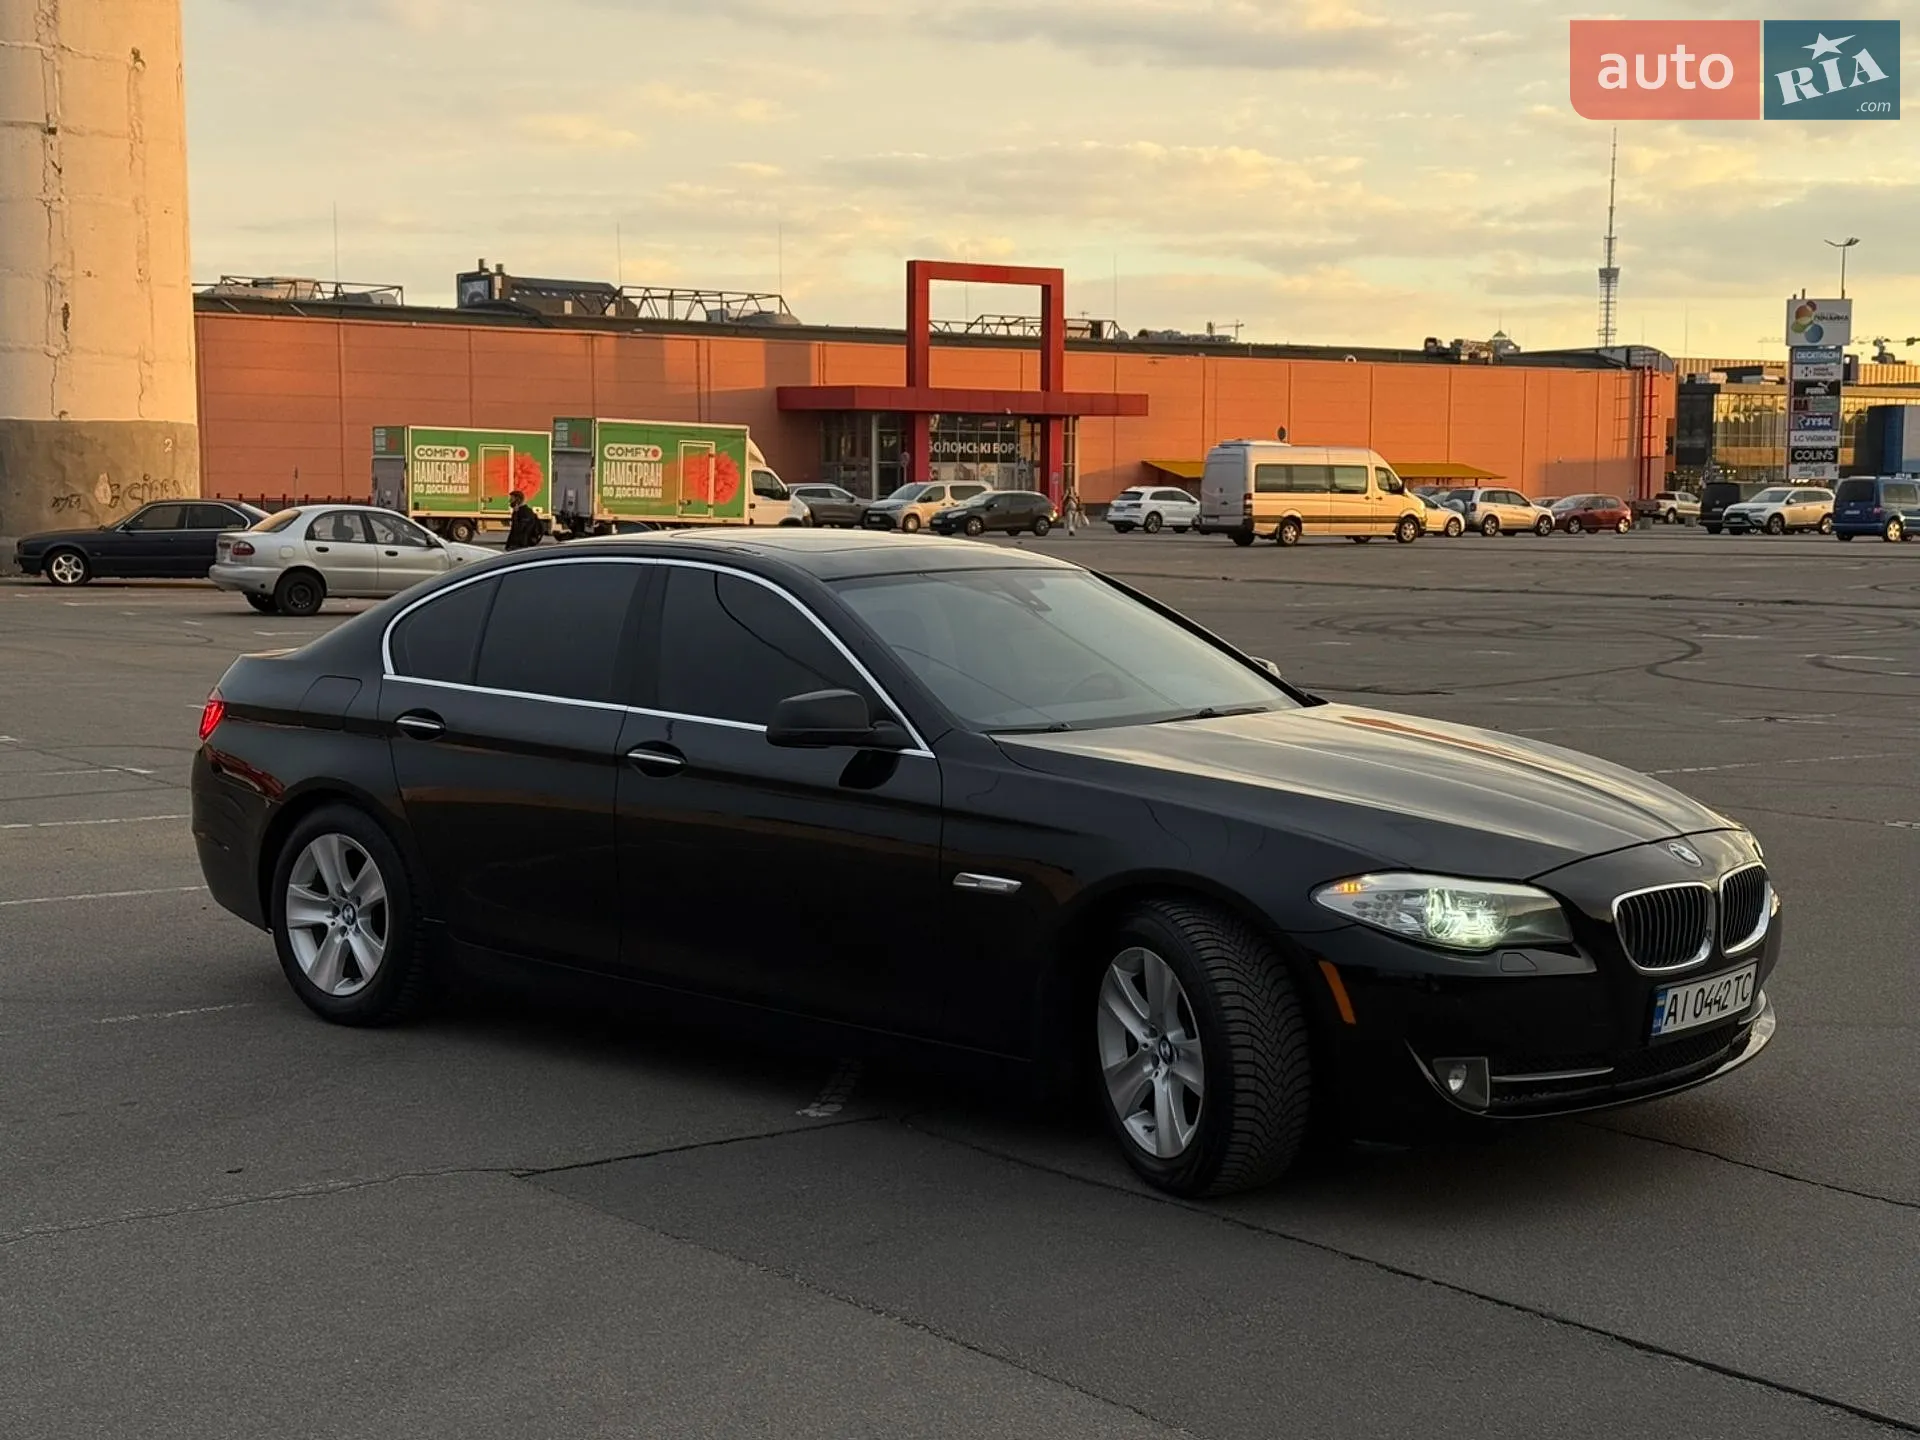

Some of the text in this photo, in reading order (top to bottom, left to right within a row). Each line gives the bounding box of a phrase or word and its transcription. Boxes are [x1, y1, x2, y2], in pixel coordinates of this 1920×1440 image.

[1805, 417, 1831, 427] JYSK
[416, 447, 458, 458] COMFY
[606, 446, 651, 457] COMFY
[413, 460, 470, 484] НАМБЕРВАН
[602, 461, 663, 486] НАМБЕРВАН
[1664, 972, 1752, 1026] AI 0442 TC
